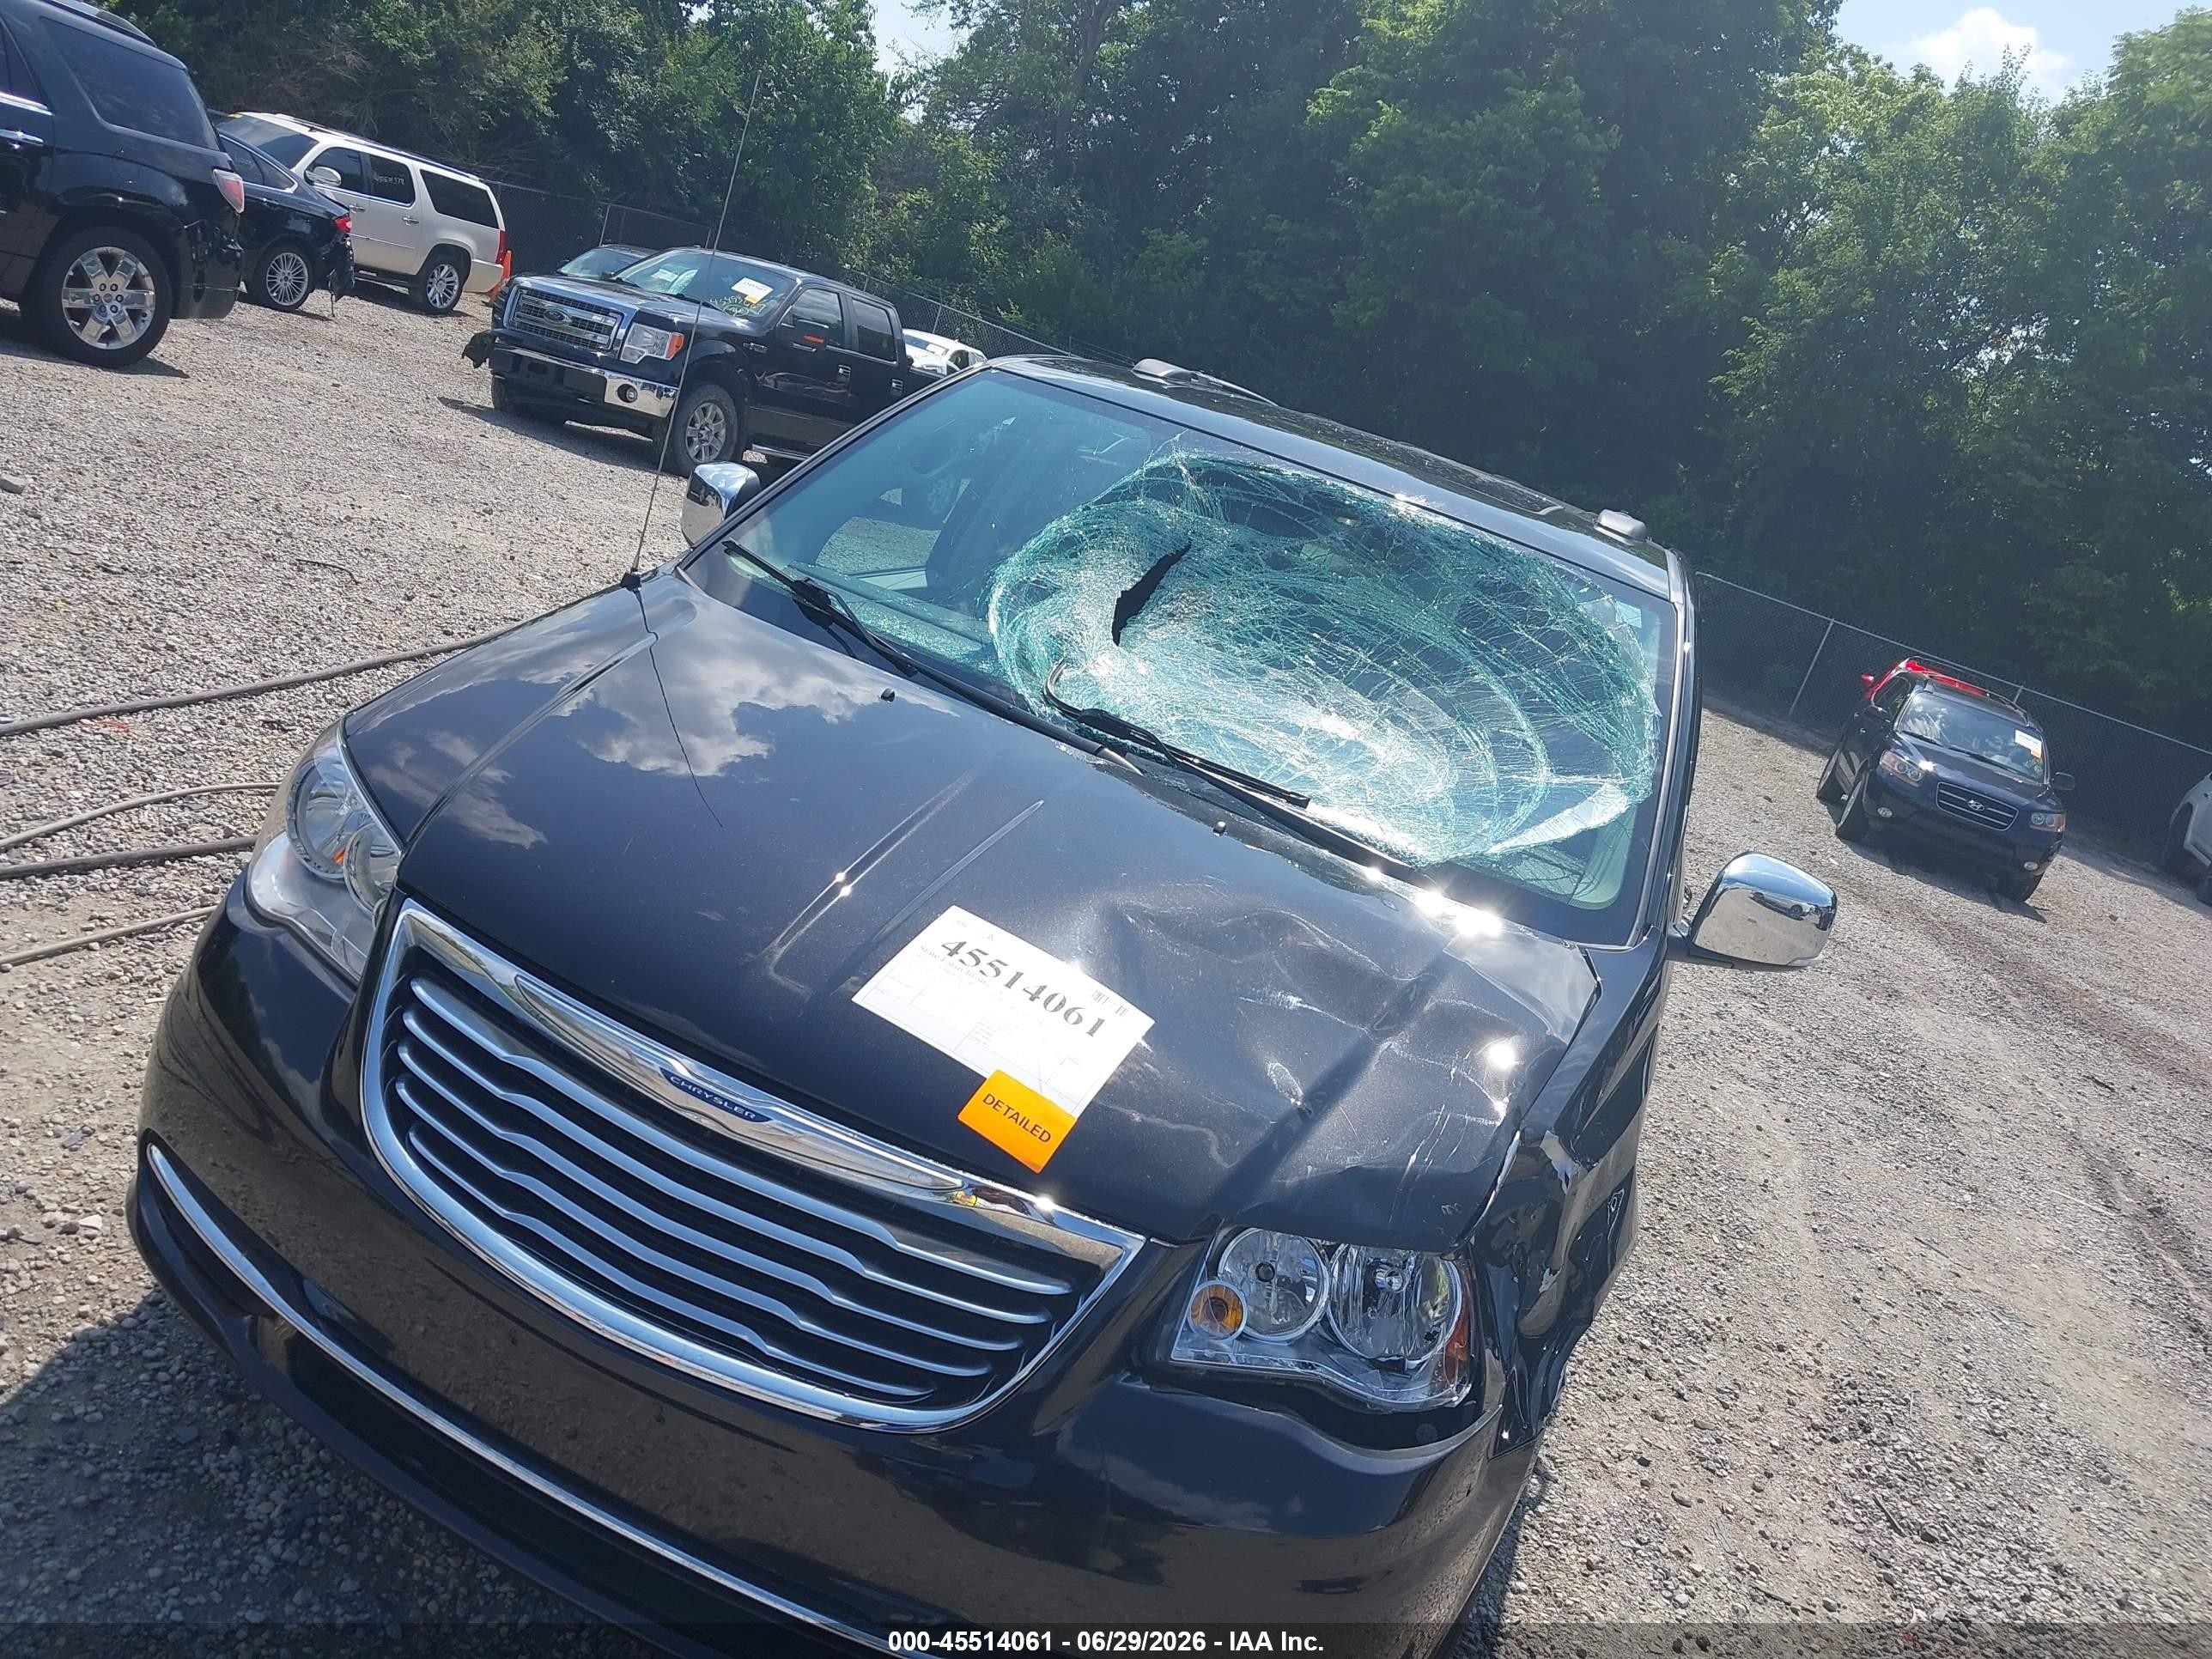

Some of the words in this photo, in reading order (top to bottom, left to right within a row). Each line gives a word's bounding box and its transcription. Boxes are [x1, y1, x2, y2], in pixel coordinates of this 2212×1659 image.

[941, 941, 1105, 1037] 45514061
[670, 1075, 757, 1120] CHRYSLER
[982, 1093, 1052, 1144] DETAILED
